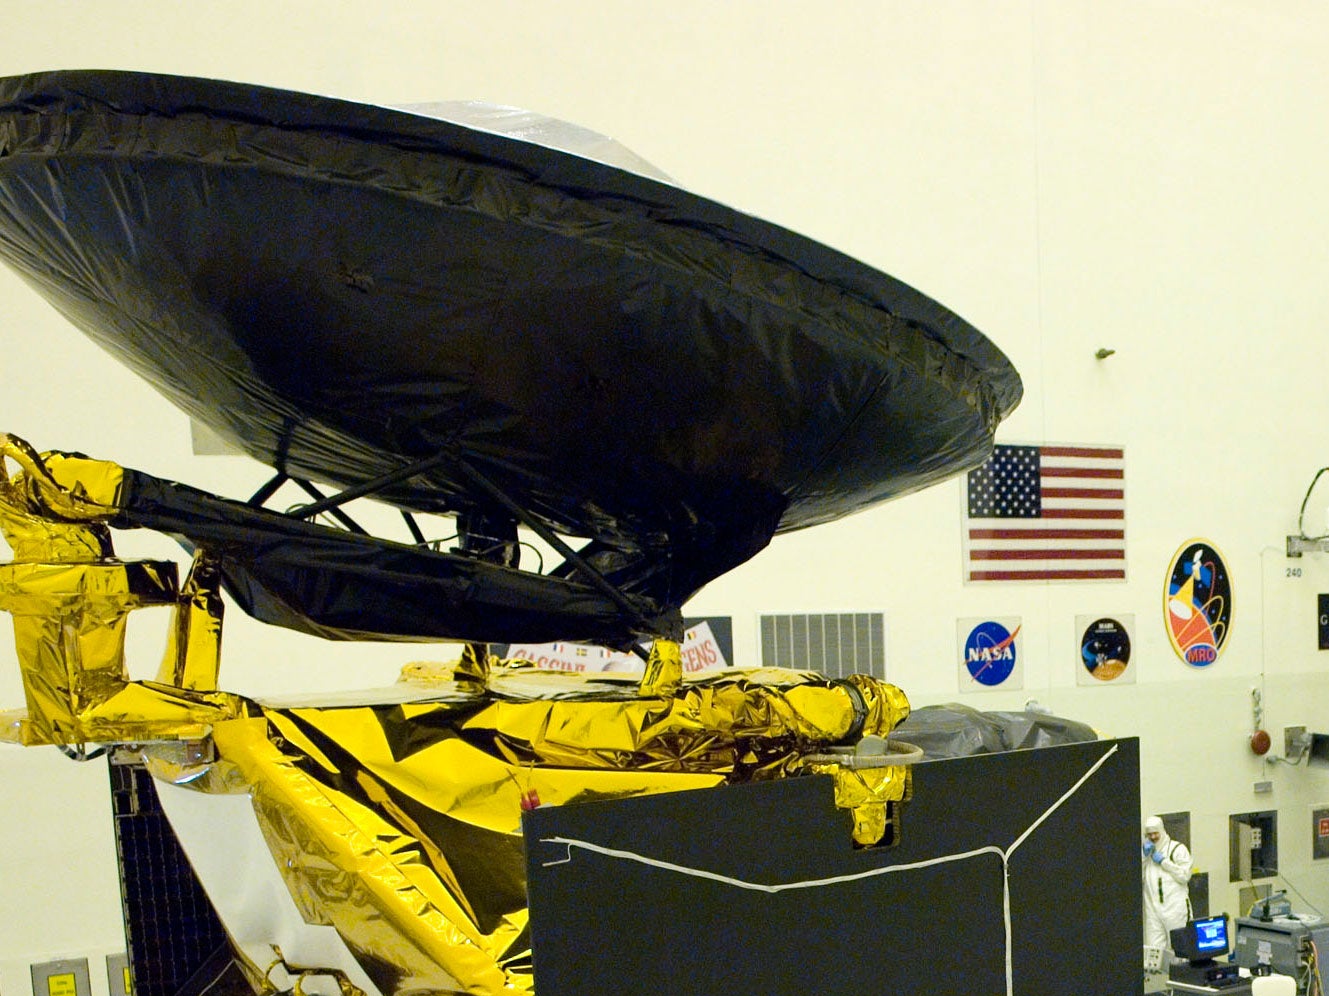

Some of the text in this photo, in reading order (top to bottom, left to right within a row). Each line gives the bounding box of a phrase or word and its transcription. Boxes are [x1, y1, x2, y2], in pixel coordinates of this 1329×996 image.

[1286, 568, 1302, 578] 240
[968, 646, 1014, 662] NASA
[1187, 649, 1216, 663] MRO
